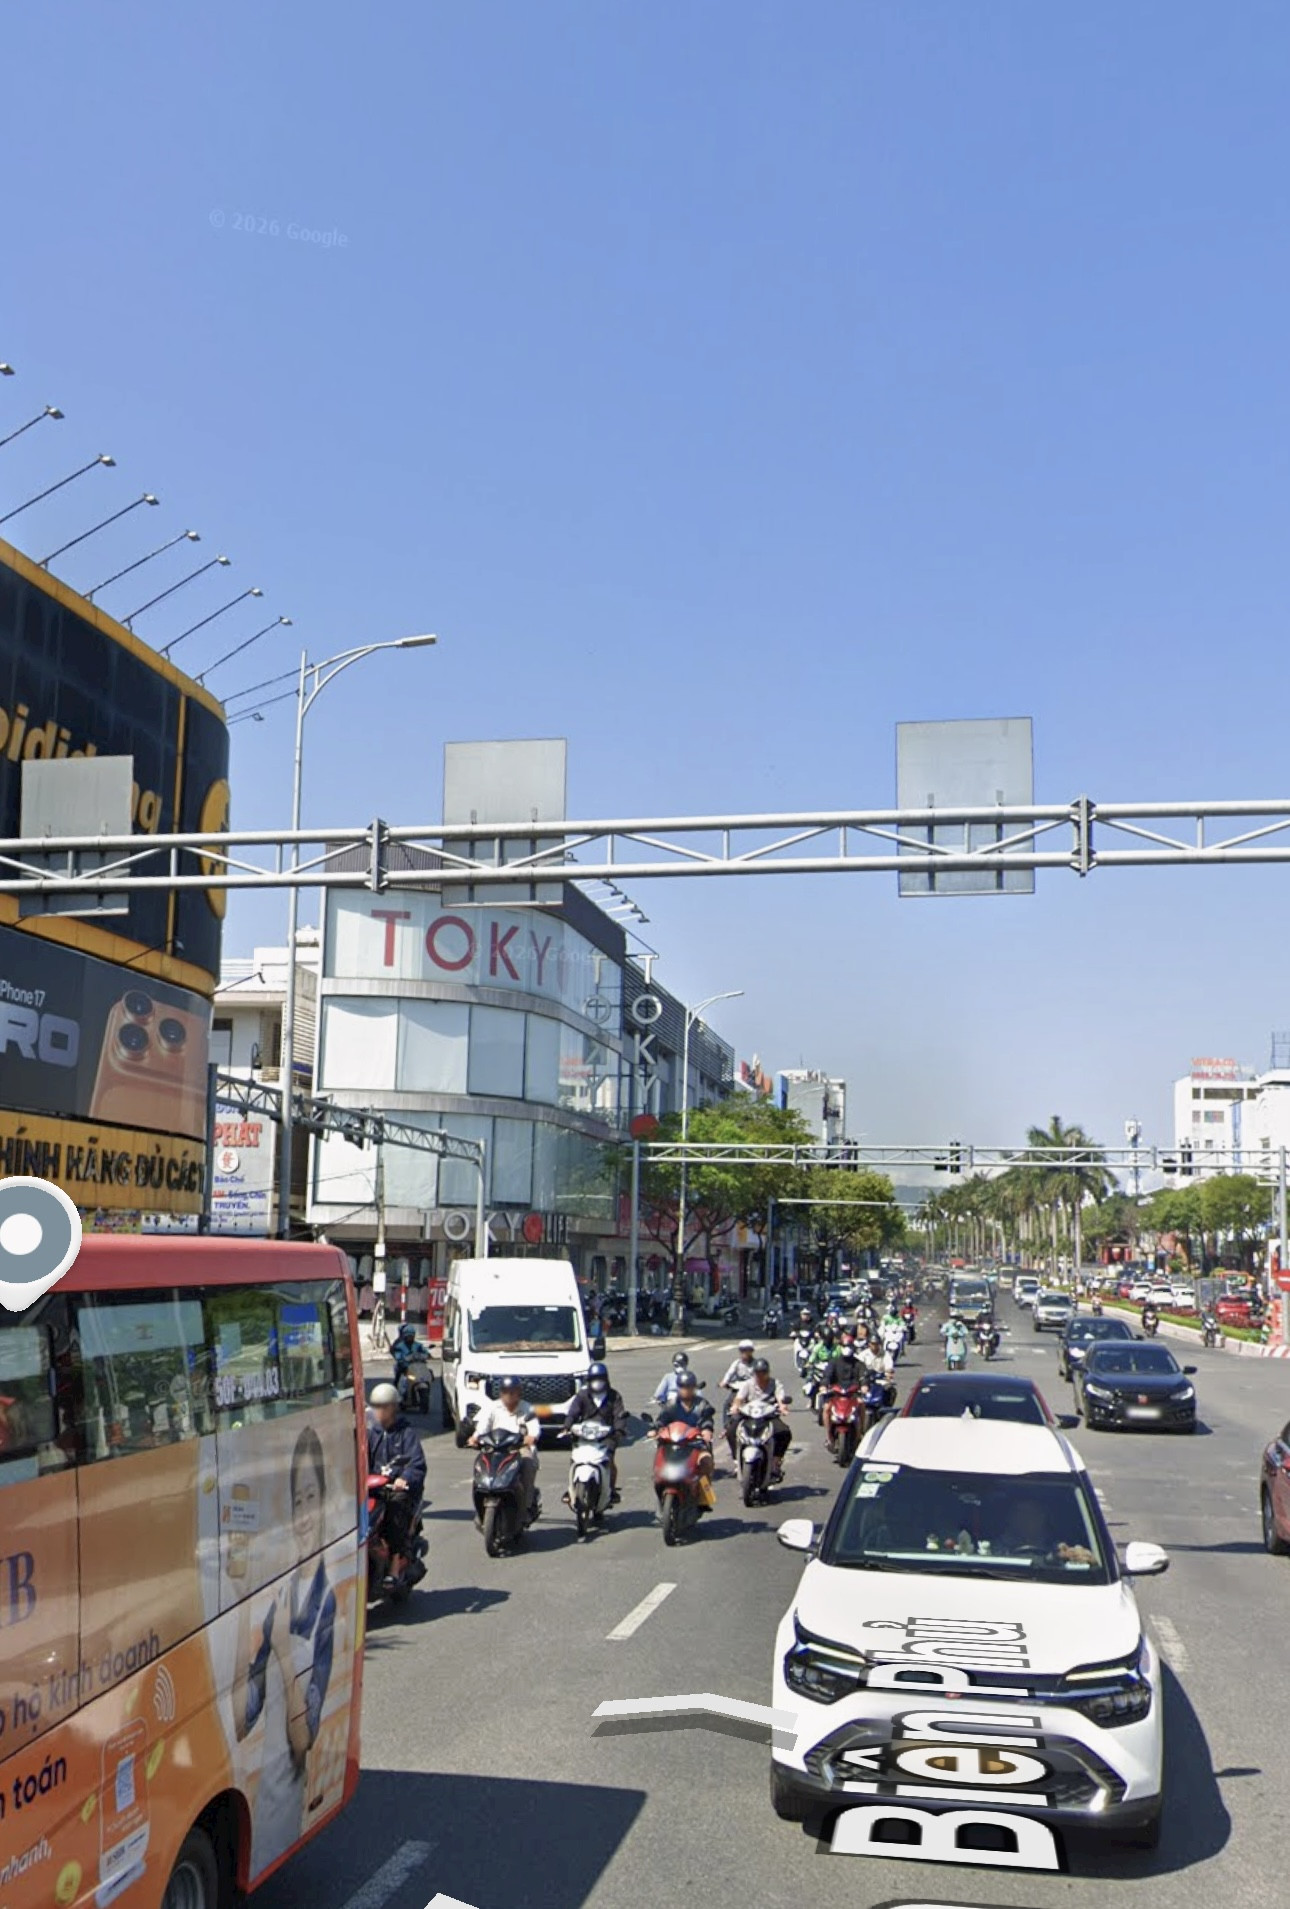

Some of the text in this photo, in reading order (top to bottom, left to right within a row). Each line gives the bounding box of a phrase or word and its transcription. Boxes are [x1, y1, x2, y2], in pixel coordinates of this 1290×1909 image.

[13, 1682, 42, 1735] hộ
[49, 1659, 93, 1710] kinh
[99, 1627, 160, 1685] doanh
[13, 1754, 67, 1811] toán
